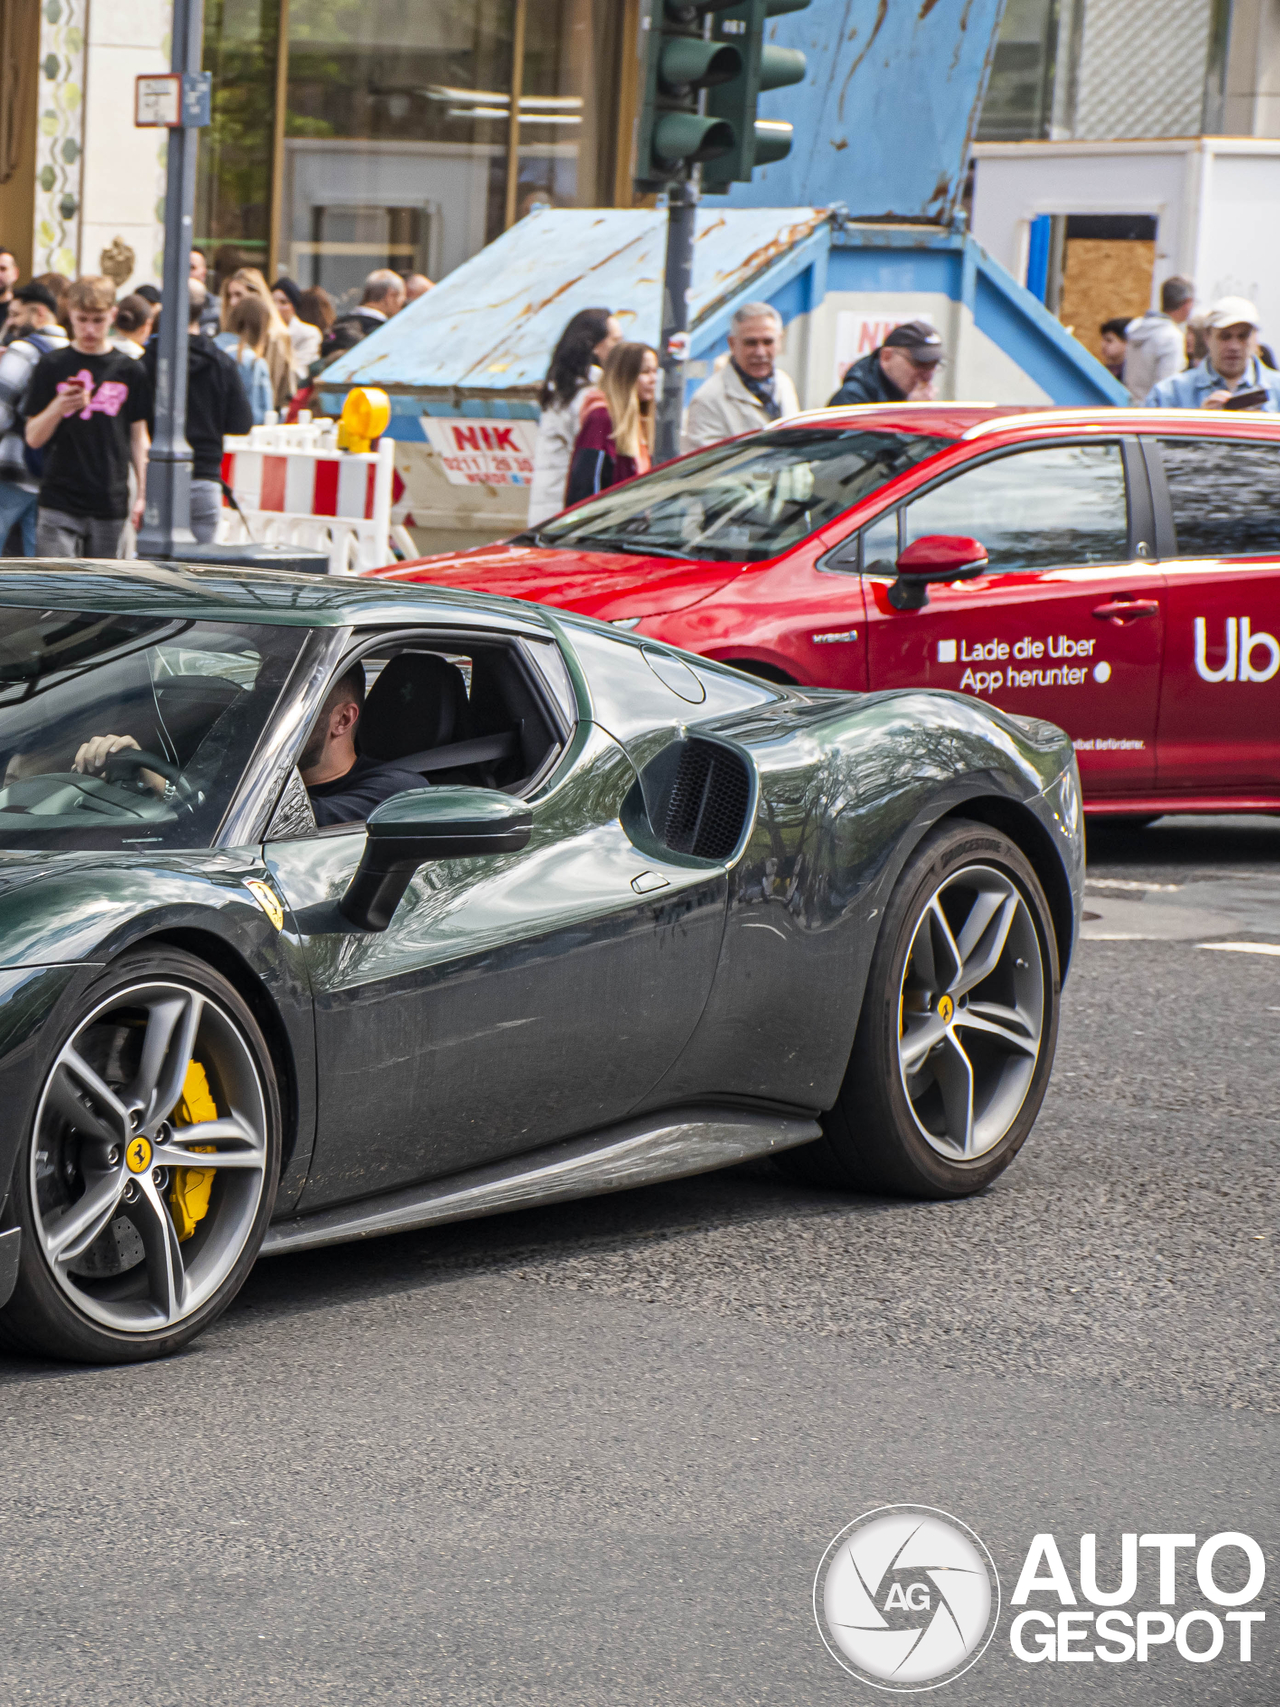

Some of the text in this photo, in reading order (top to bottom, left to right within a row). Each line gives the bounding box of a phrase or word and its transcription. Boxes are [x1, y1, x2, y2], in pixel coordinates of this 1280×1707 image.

[857, 321, 902, 353] NI
[451, 426, 522, 452] NIK
[960, 635, 1096, 662] Lade die Uber
[1194, 616, 1280, 682] Ub
[960, 664, 1089, 695] App herunter
